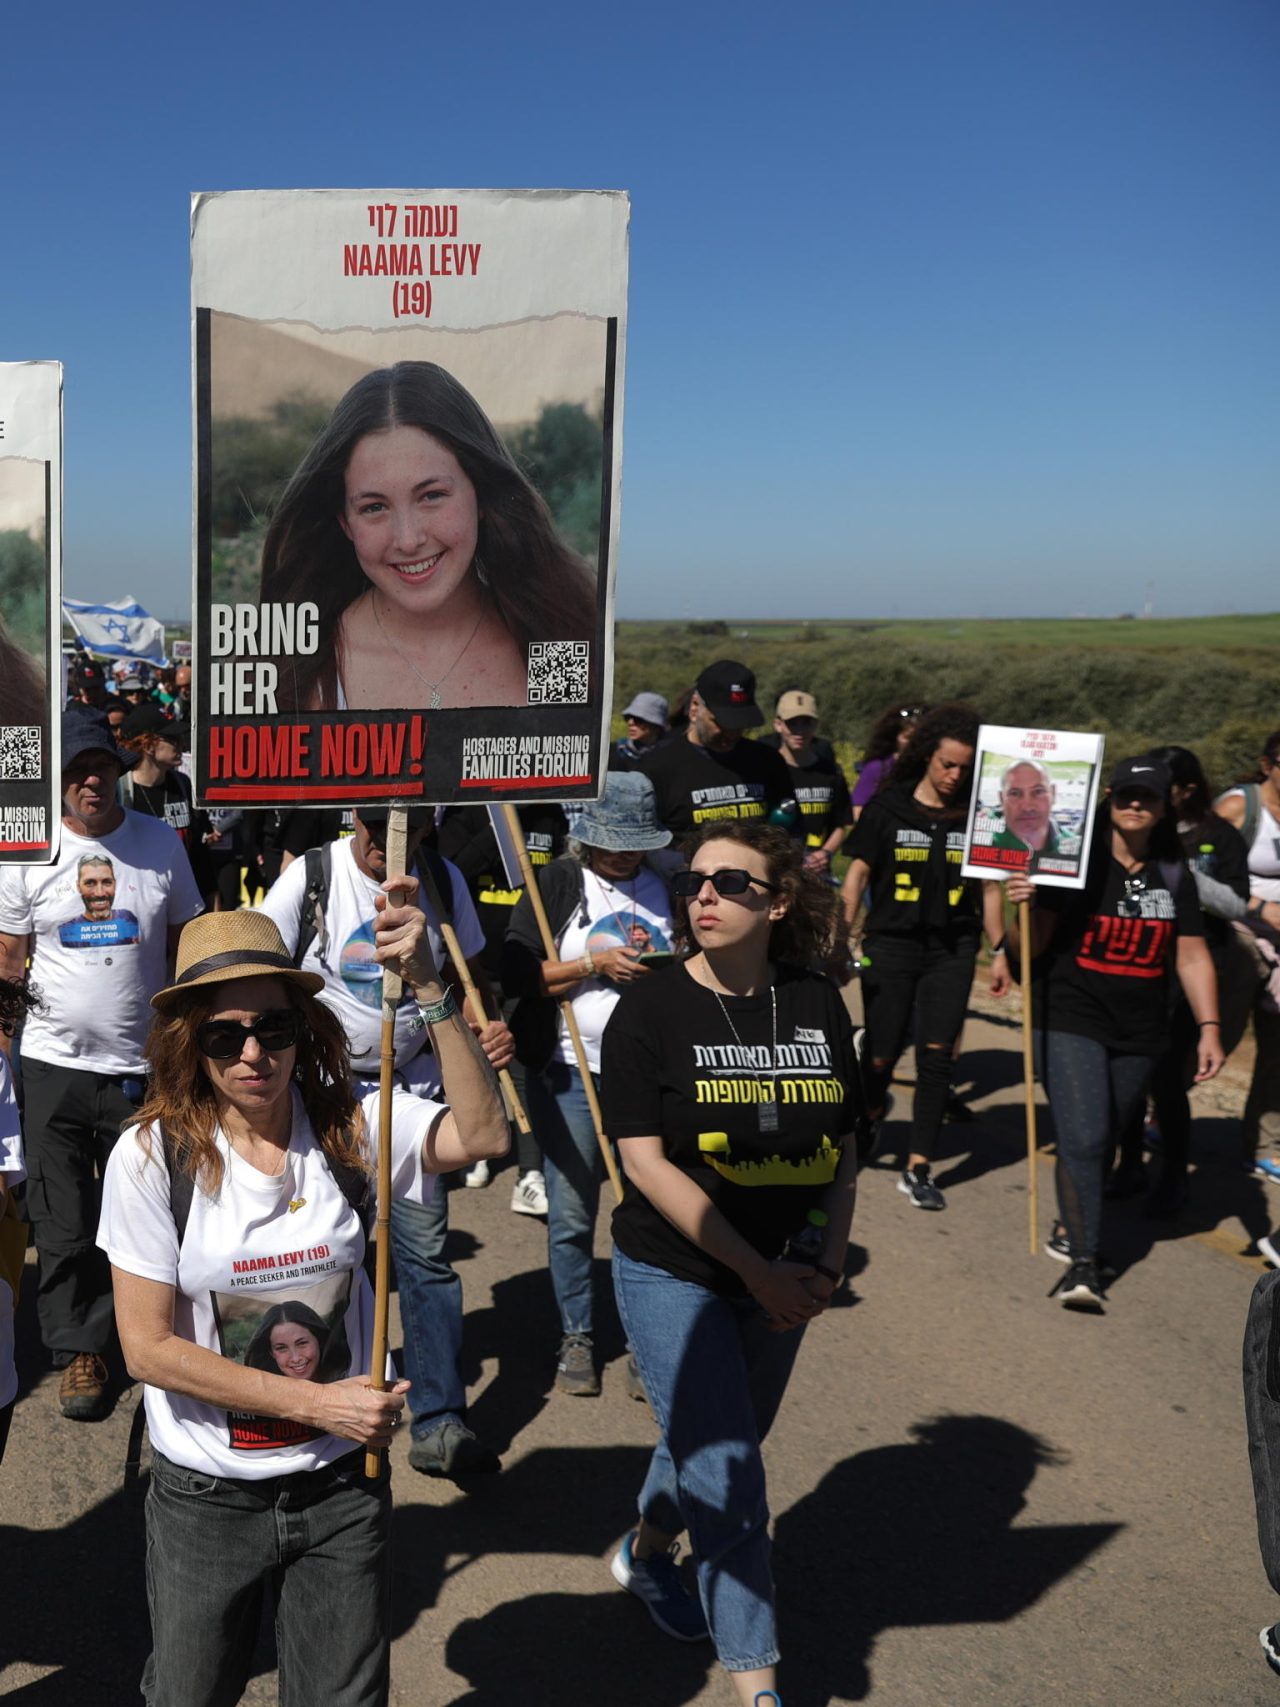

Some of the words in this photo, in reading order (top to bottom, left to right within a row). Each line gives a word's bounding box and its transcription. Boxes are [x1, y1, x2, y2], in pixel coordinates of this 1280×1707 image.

[368, 203, 397, 238] לוי
[404, 205, 458, 238] נעמה
[344, 244, 423, 276] NAAMA
[430, 244, 481, 276] LEVY
[392, 280, 432, 318] (19)
[210, 601, 319, 657] BRING
[210, 662, 278, 716] HER
[209, 725, 310, 779] HOME
[320, 715, 424, 777] NOW!
[462, 737, 516, 756] HOSTAGES
[519, 736, 540, 754] AND
[542, 735, 590, 754] MISSING
[462, 757, 530, 780] FAMILIES
[534, 754, 589, 778] FORUM
[4, 806, 46, 822] MISSING
[696, 1080, 776, 1104] החטופות
[781, 1078, 844, 1104] להחזרת
[230, 1278, 236, 1287] A
[236, 1276, 258, 1286] PEACE
[260, 1272, 284, 1283] SEEKER
[286, 1270, 300, 1278] AND
[301, 1260, 336, 1276] TRIATHLETE
[233, 1256, 276, 1273] NAAMA
[278, 1250, 304, 1266] LEVY
[308, 1244, 330, 1260] (19)
